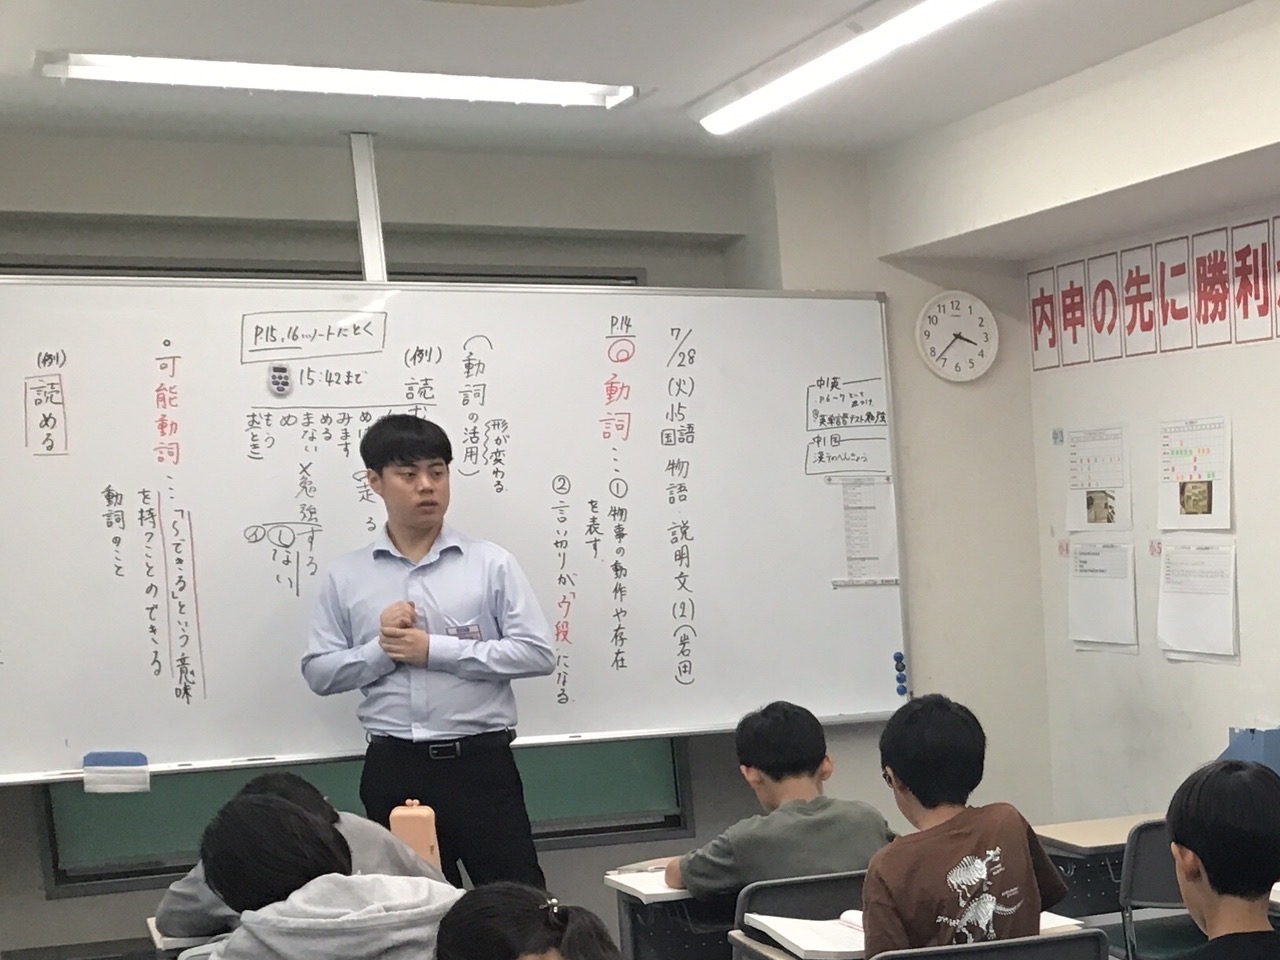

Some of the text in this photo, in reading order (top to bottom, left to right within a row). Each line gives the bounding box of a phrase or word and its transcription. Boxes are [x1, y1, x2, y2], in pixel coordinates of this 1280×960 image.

[937, 303, 946, 314] 11
[950, 300, 961, 311] 12
[968, 305, 973, 315] 1
[928, 315, 938, 325] 10
[978, 317, 984, 327] 2
[924, 330, 930, 340] 9
[983, 332, 989, 342] 3
[930, 346, 936, 357] 8
[978, 349, 984, 358] 4
[941, 357, 947, 368] 7
[955, 362, 961, 372] 6
[969, 359, 975, 369] 5
[30, 379, 64, 451] 読める
[301, 411, 318, 452] まない
[320, 413, 333, 441] める
[336, 412, 353, 457] みます
[101, 484, 126, 577] 動詞のこと
